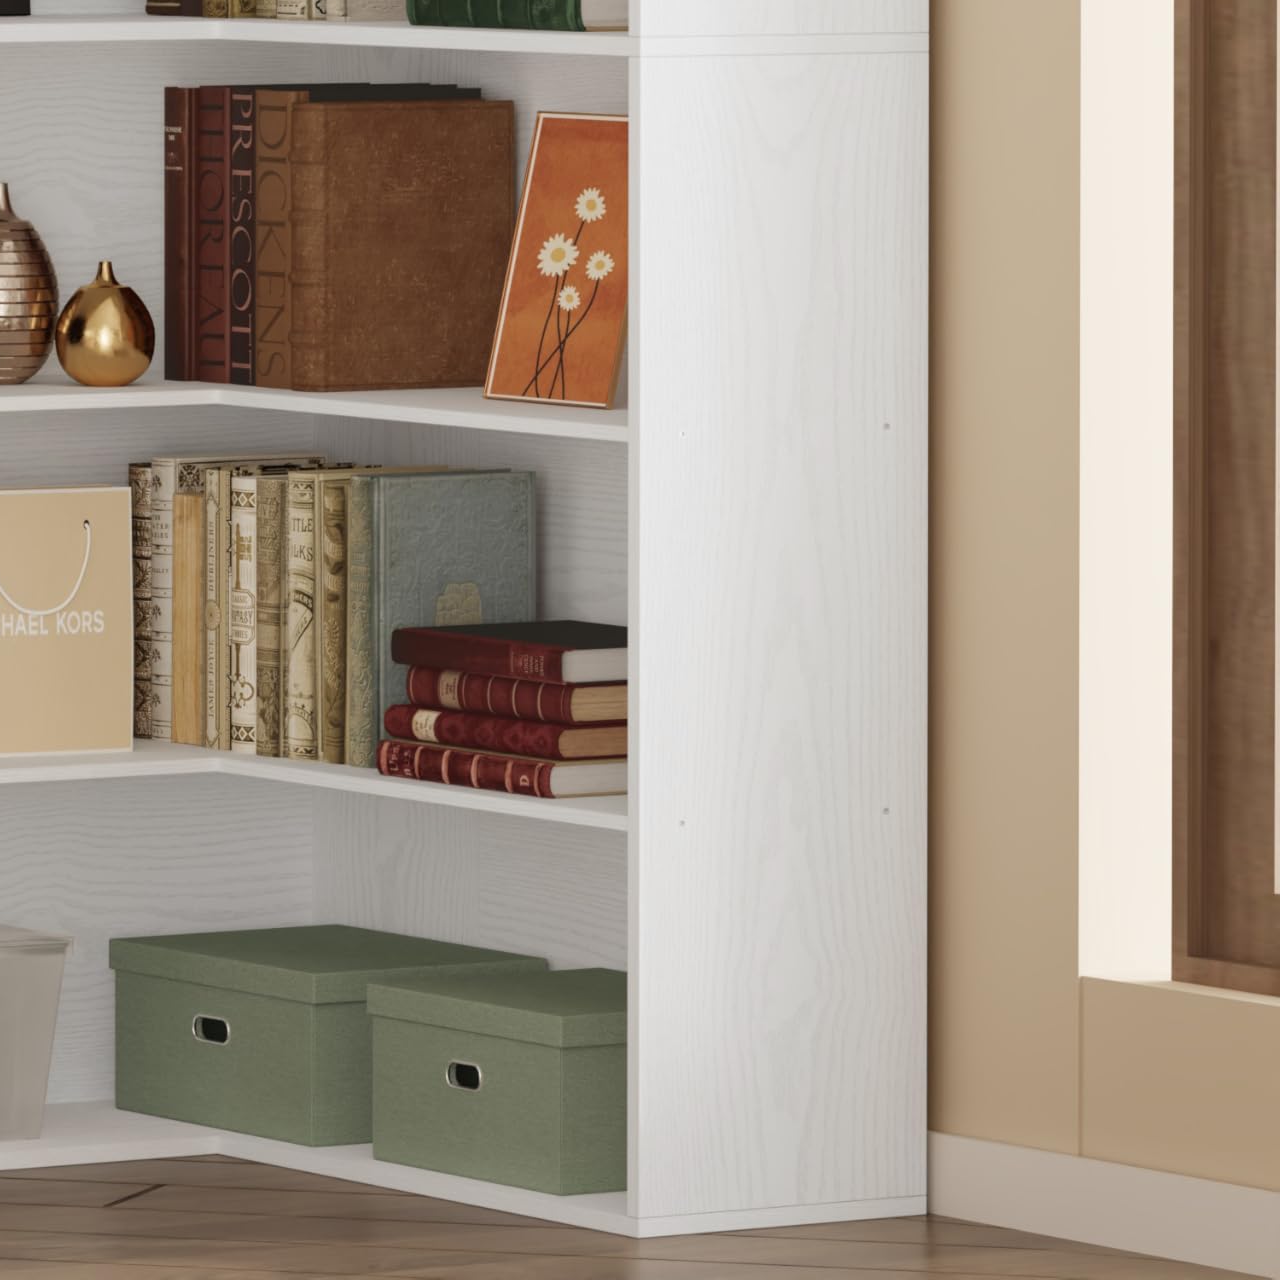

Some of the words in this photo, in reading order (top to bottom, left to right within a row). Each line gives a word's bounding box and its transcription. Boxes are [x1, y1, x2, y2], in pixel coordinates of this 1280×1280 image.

[199, 102, 225, 368] THOREAU
[231, 93, 254, 385] PRESCOTT
[257, 104, 287, 377] DICKENS
[55, 611, 105, 635] KORS
